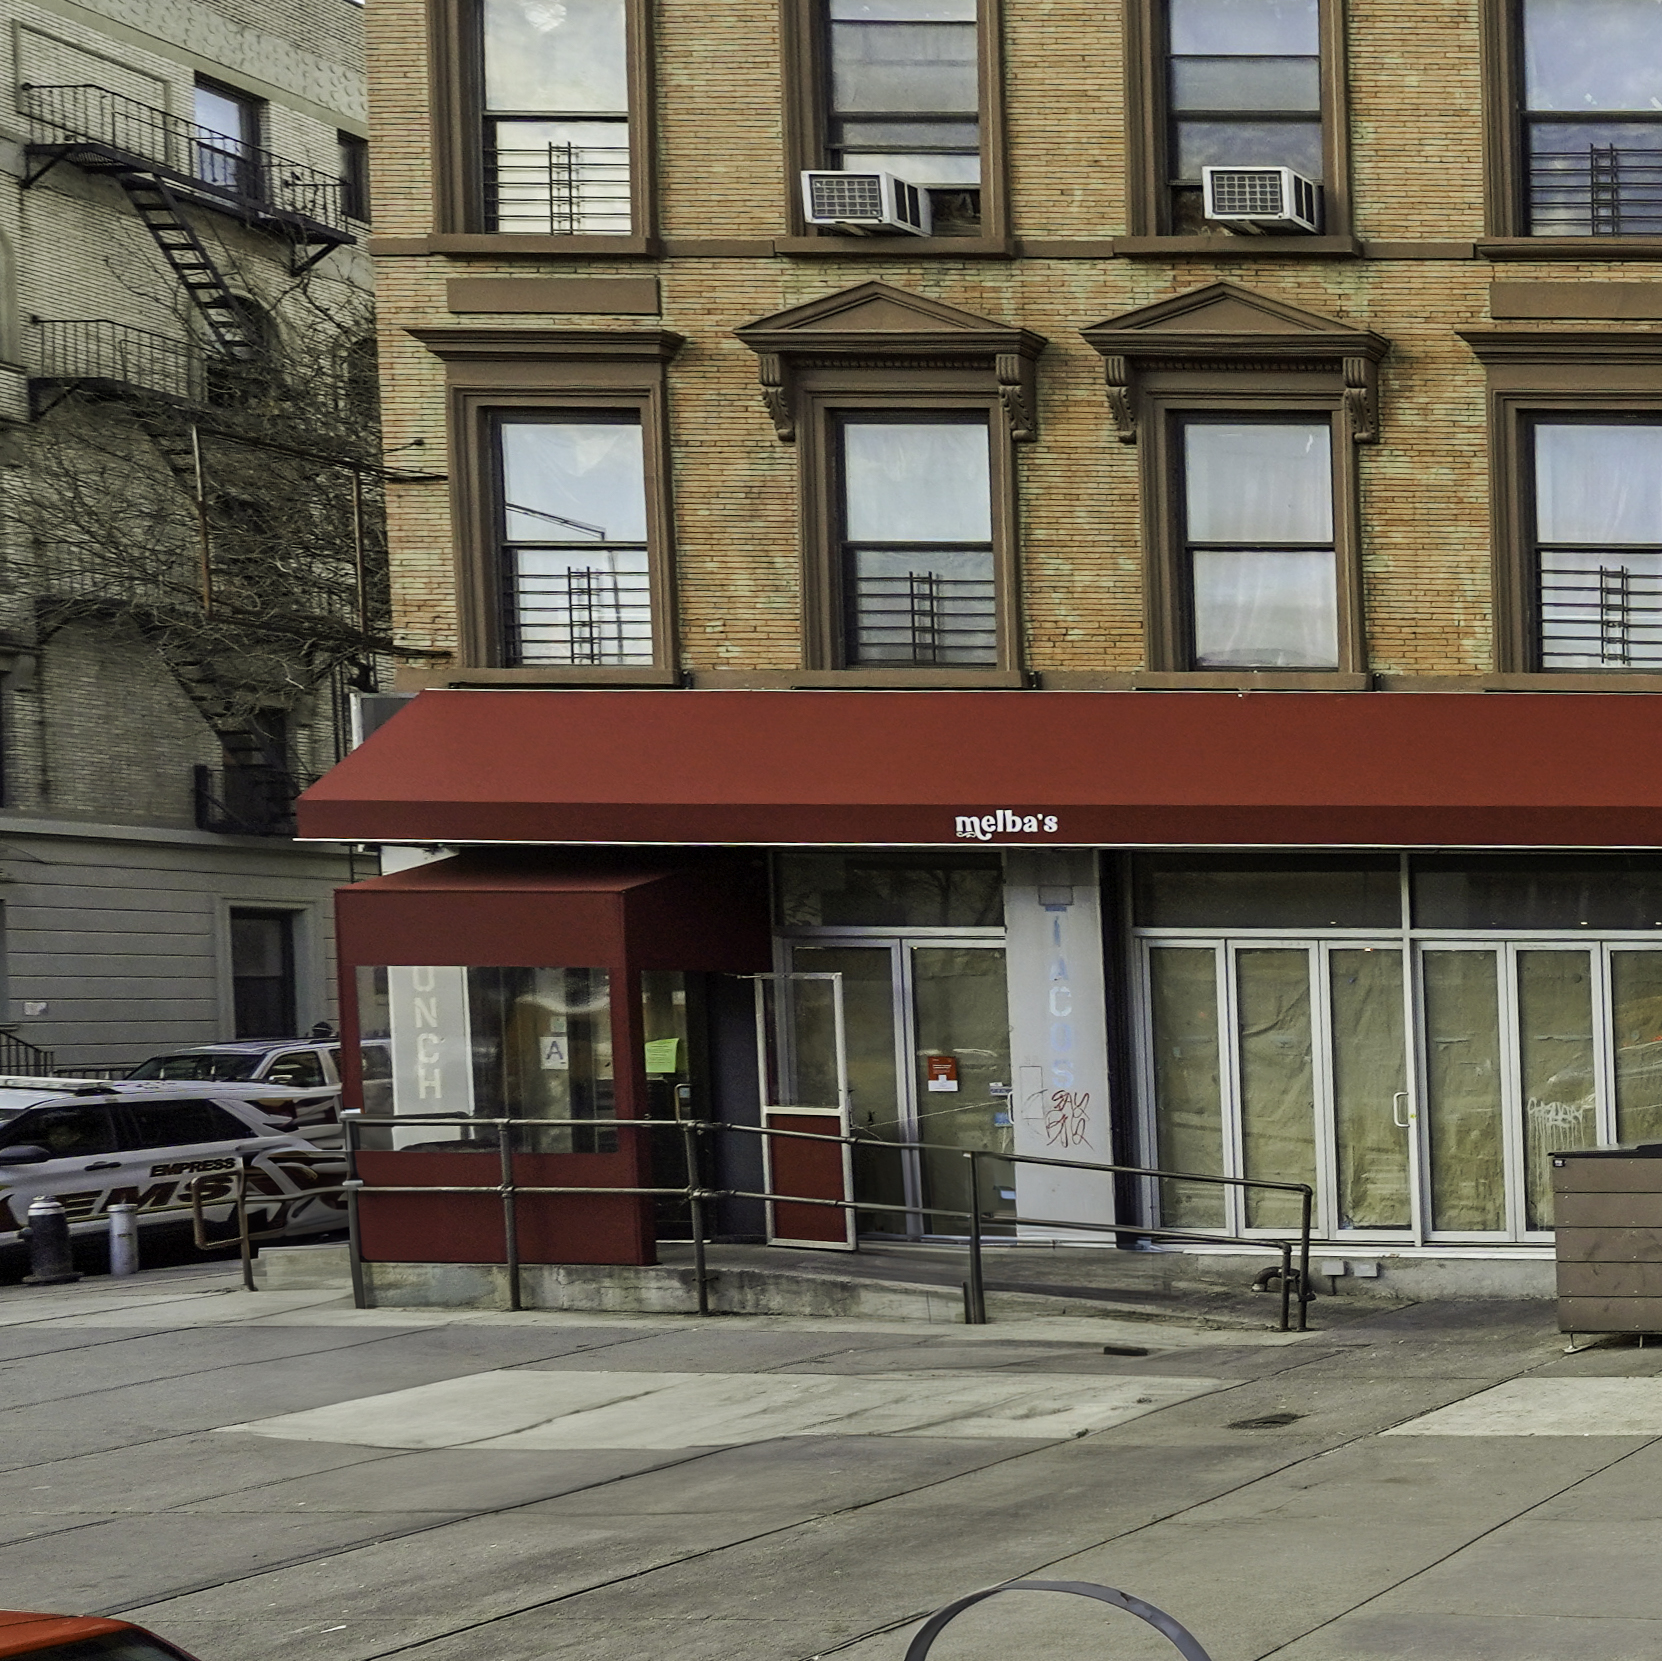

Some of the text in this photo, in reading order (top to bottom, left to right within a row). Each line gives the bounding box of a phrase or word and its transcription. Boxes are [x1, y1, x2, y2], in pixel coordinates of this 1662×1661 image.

[955, 809, 1058, 841] melba's
[545, 1040, 564, 1060] A
[149, 1157, 236, 1178] EMPRESS
[54, 1176, 233, 1217] EMS
